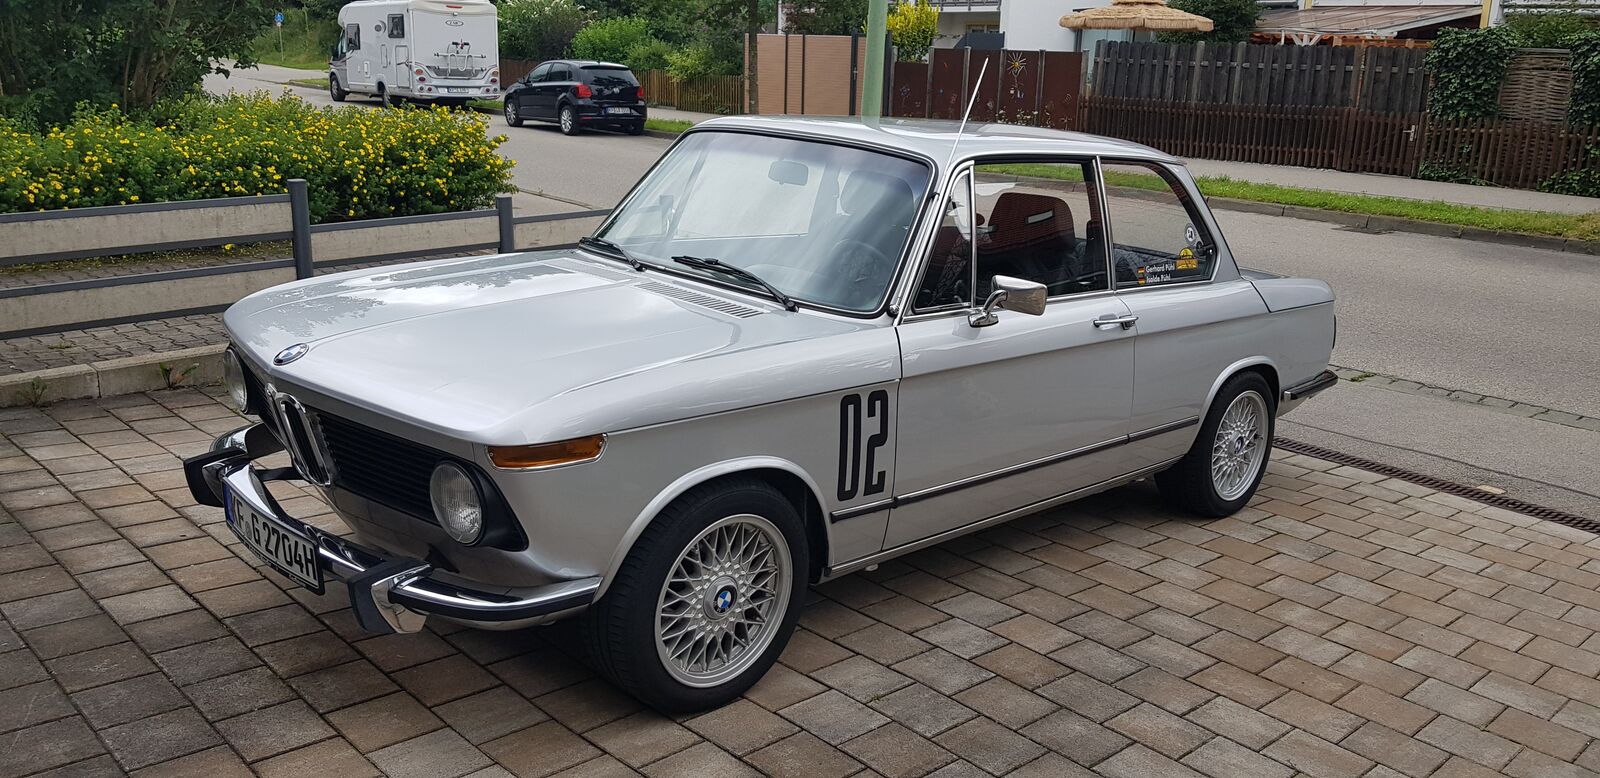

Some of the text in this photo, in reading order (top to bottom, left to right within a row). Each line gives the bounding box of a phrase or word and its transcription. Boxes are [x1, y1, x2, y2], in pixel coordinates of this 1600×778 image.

[1145, 264, 1164, 273] Gerhard
[1146, 274, 1160, 283] Isolde
[837, 389, 889, 502] 02
[251, 512, 261, 546] G
[262, 520, 317, 581] 2704H
